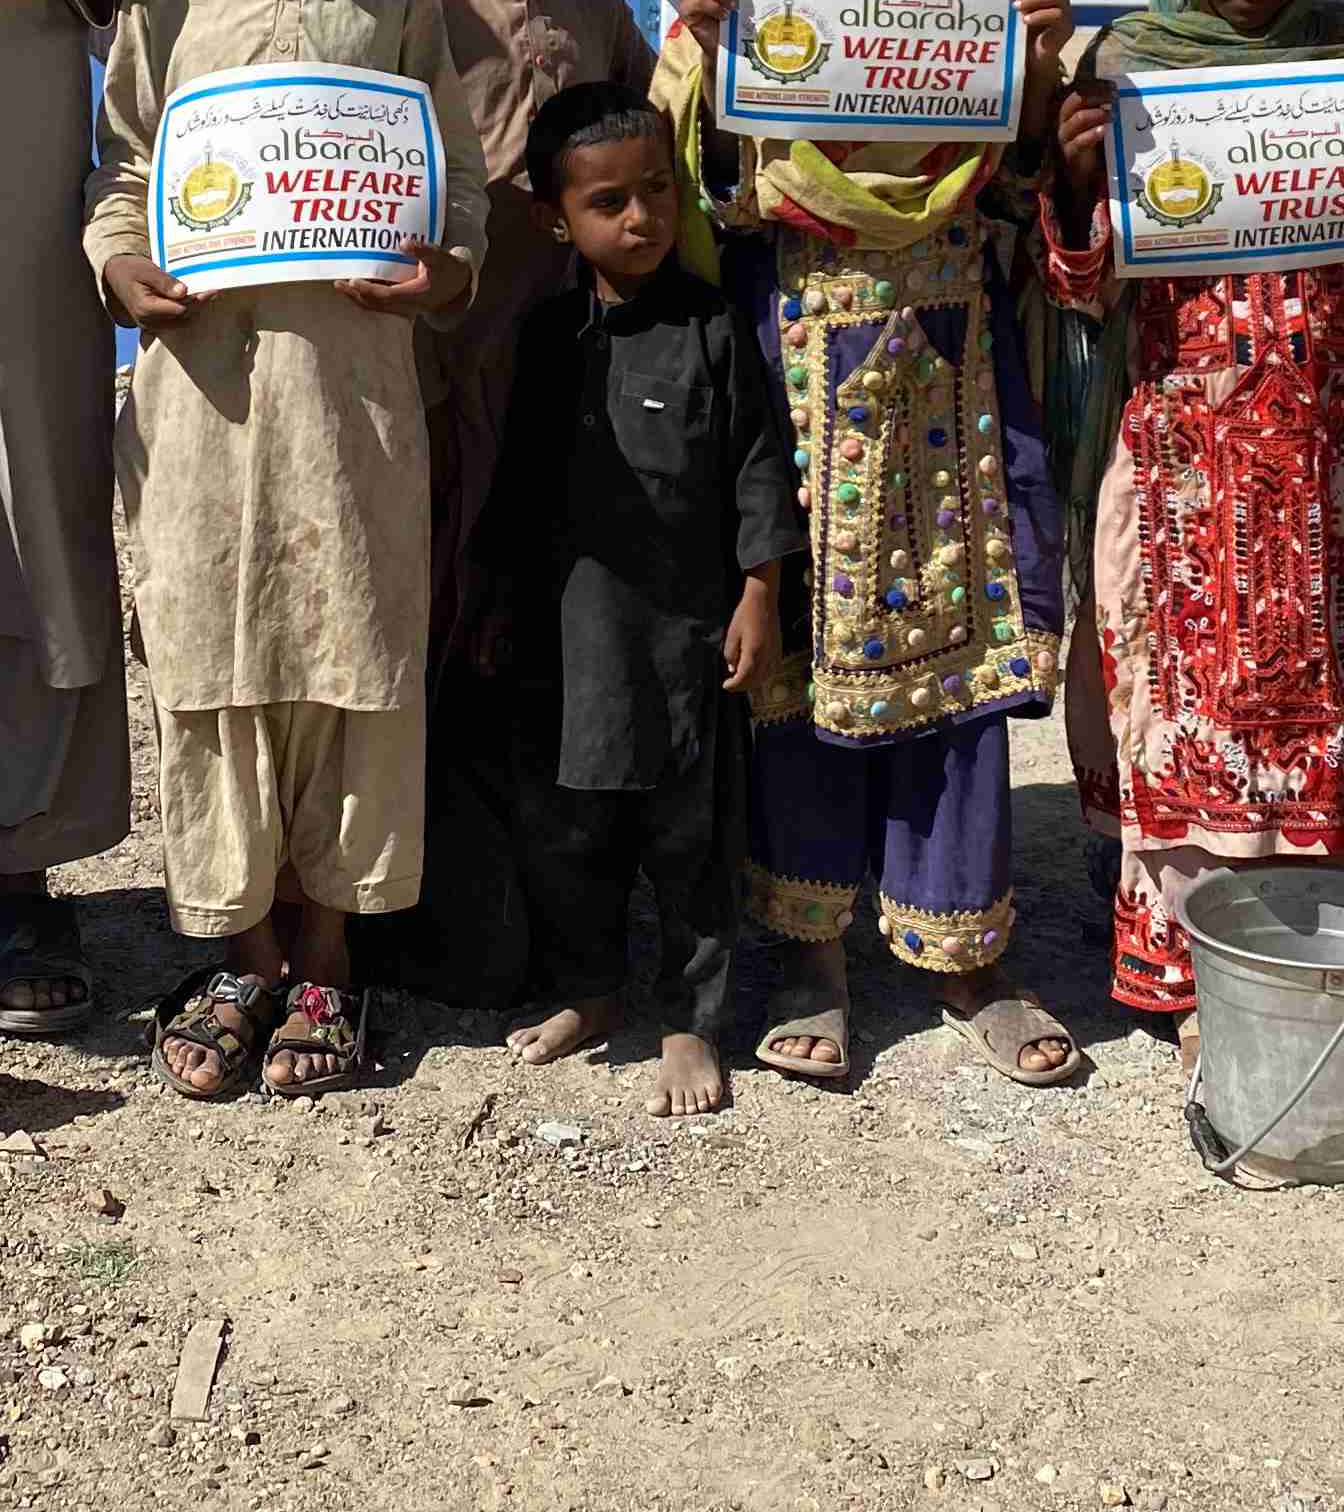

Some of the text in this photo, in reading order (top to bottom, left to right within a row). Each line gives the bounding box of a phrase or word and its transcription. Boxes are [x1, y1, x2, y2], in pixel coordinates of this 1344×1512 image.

[842, 35, 1000, 64] WELFARE
[863, 67, 976, 91] TRUST
[834, 92, 1000, 116] INTERNATIONAL
[259, 127, 425, 170] albaraka
[265, 169, 424, 197] WELFARE
[290, 199, 404, 224] TRUST
